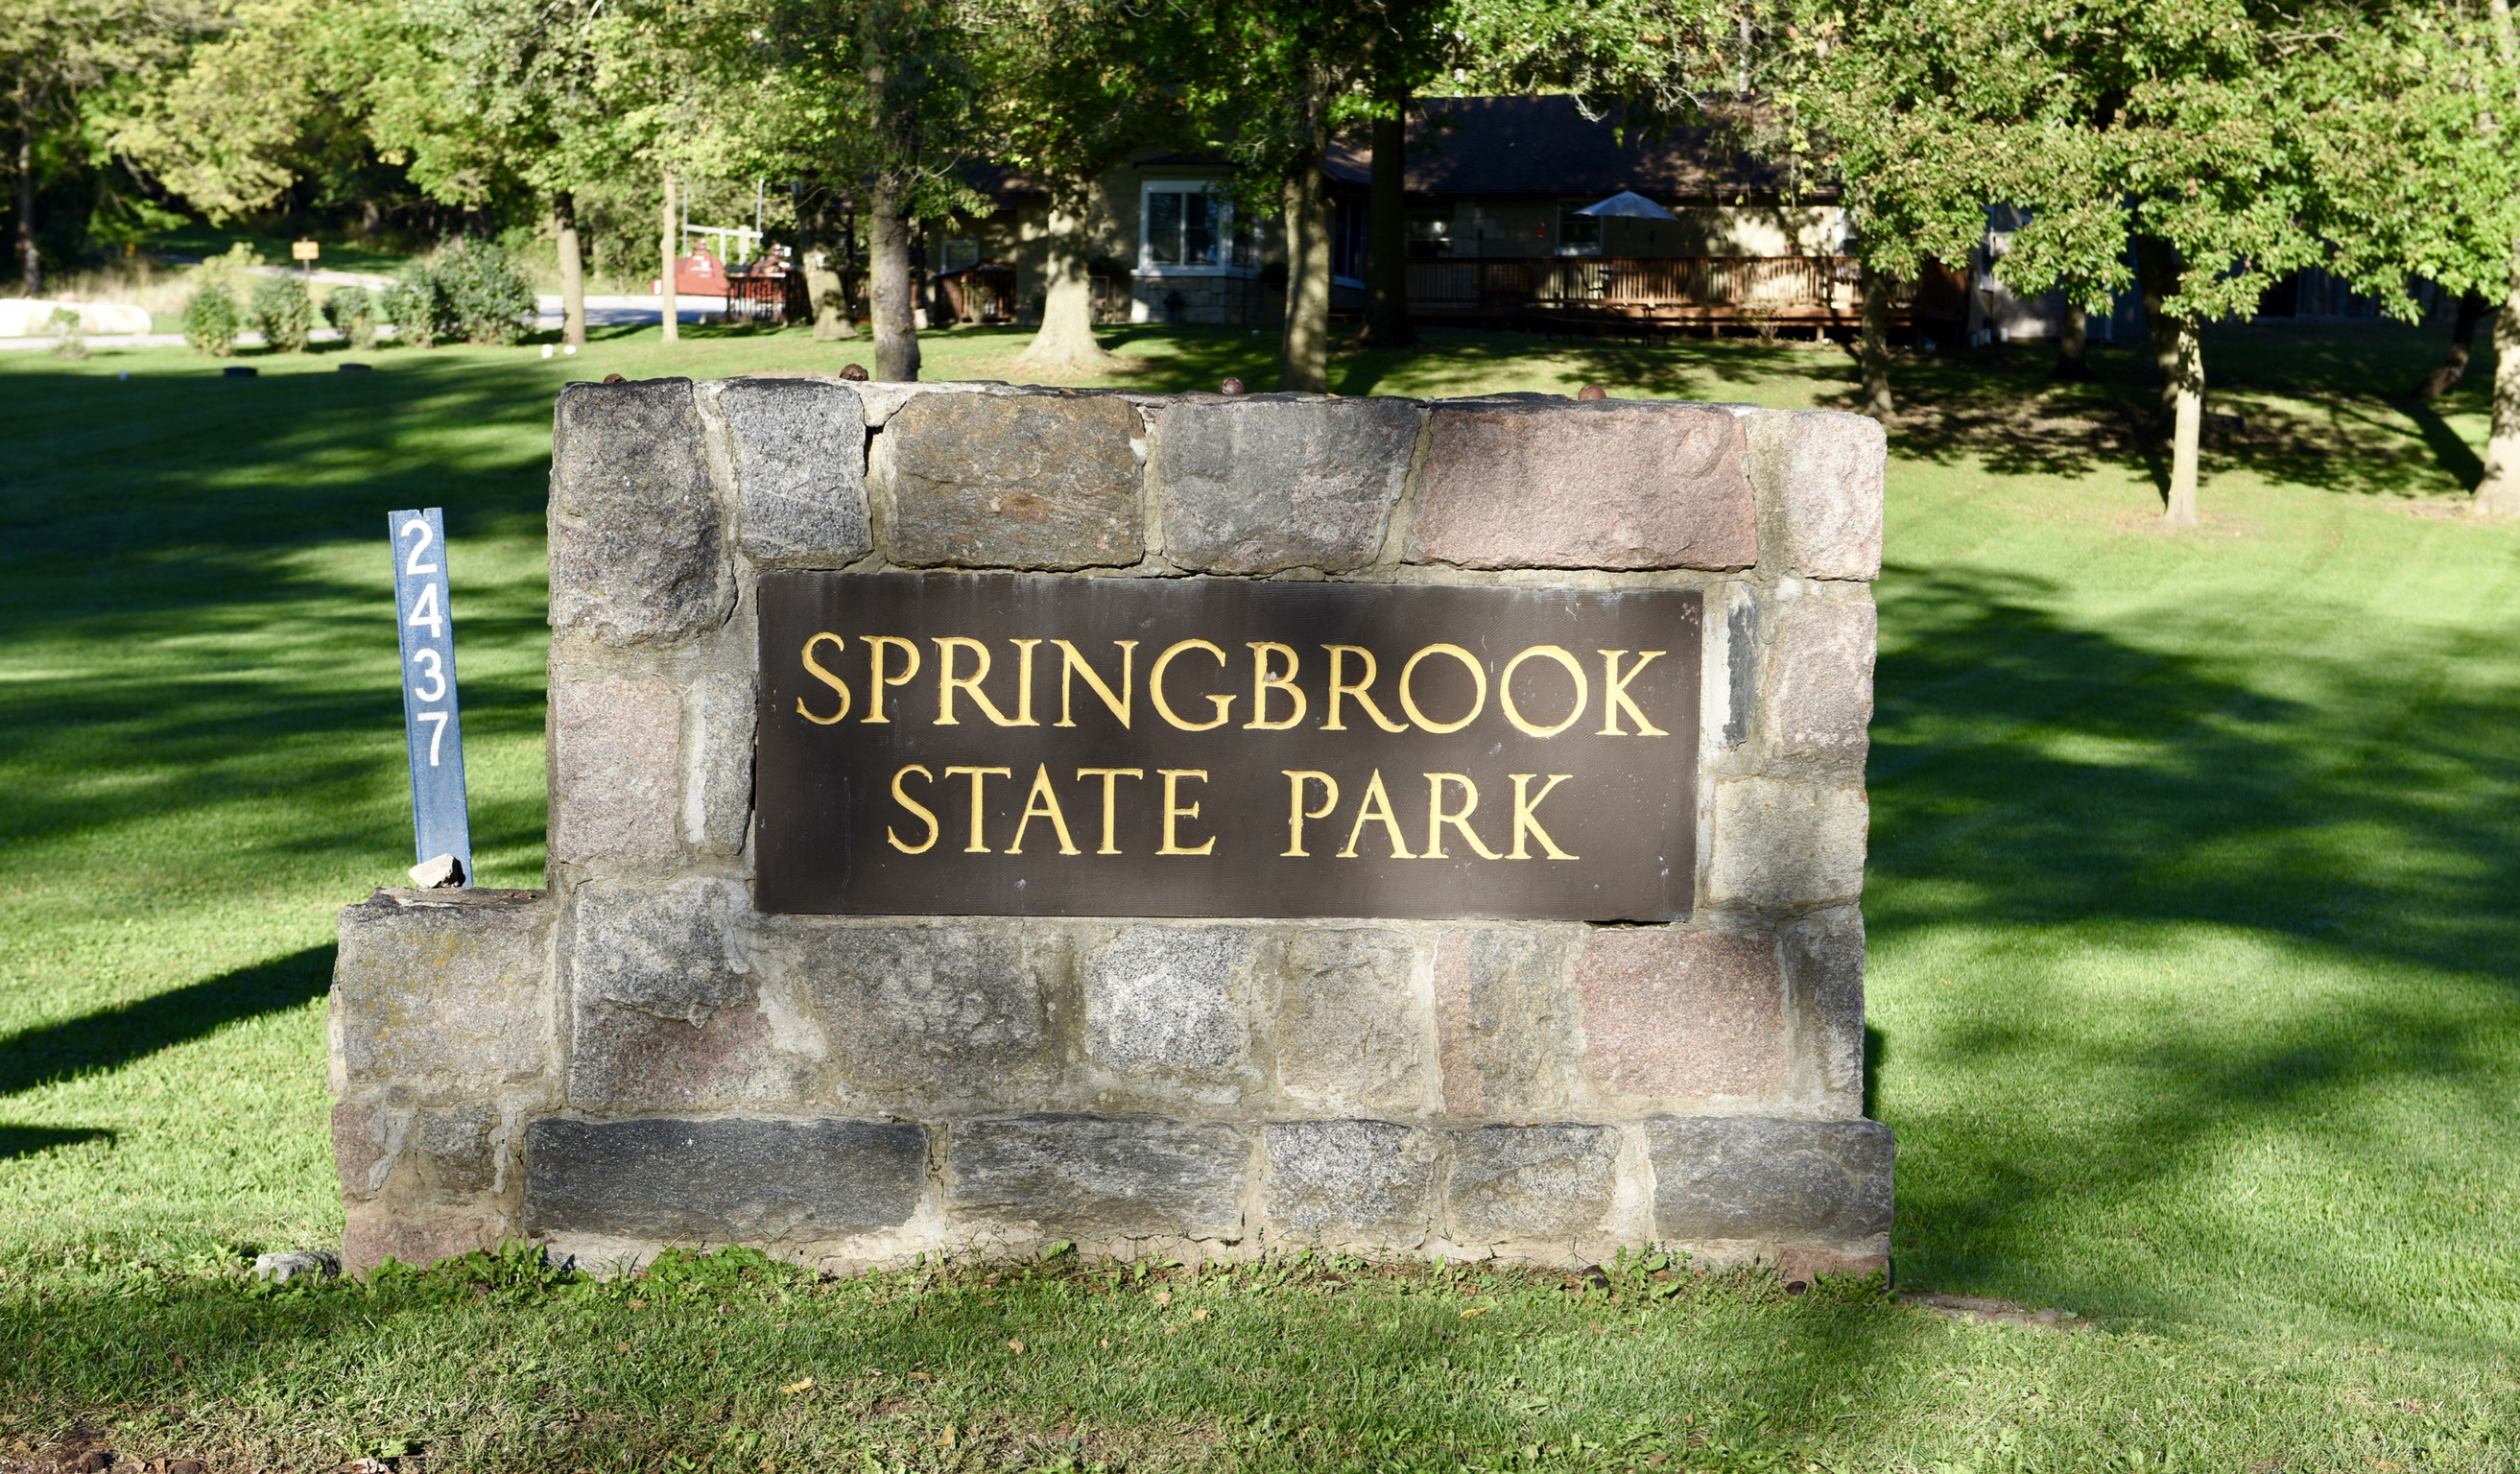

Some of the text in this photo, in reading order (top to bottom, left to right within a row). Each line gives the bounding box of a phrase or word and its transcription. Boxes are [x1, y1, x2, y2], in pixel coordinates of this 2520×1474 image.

[399, 518, 449, 767] 2437
[796, 630, 1671, 738] SPRINGBROOK
[887, 763, 1581, 862] STATE PARK
